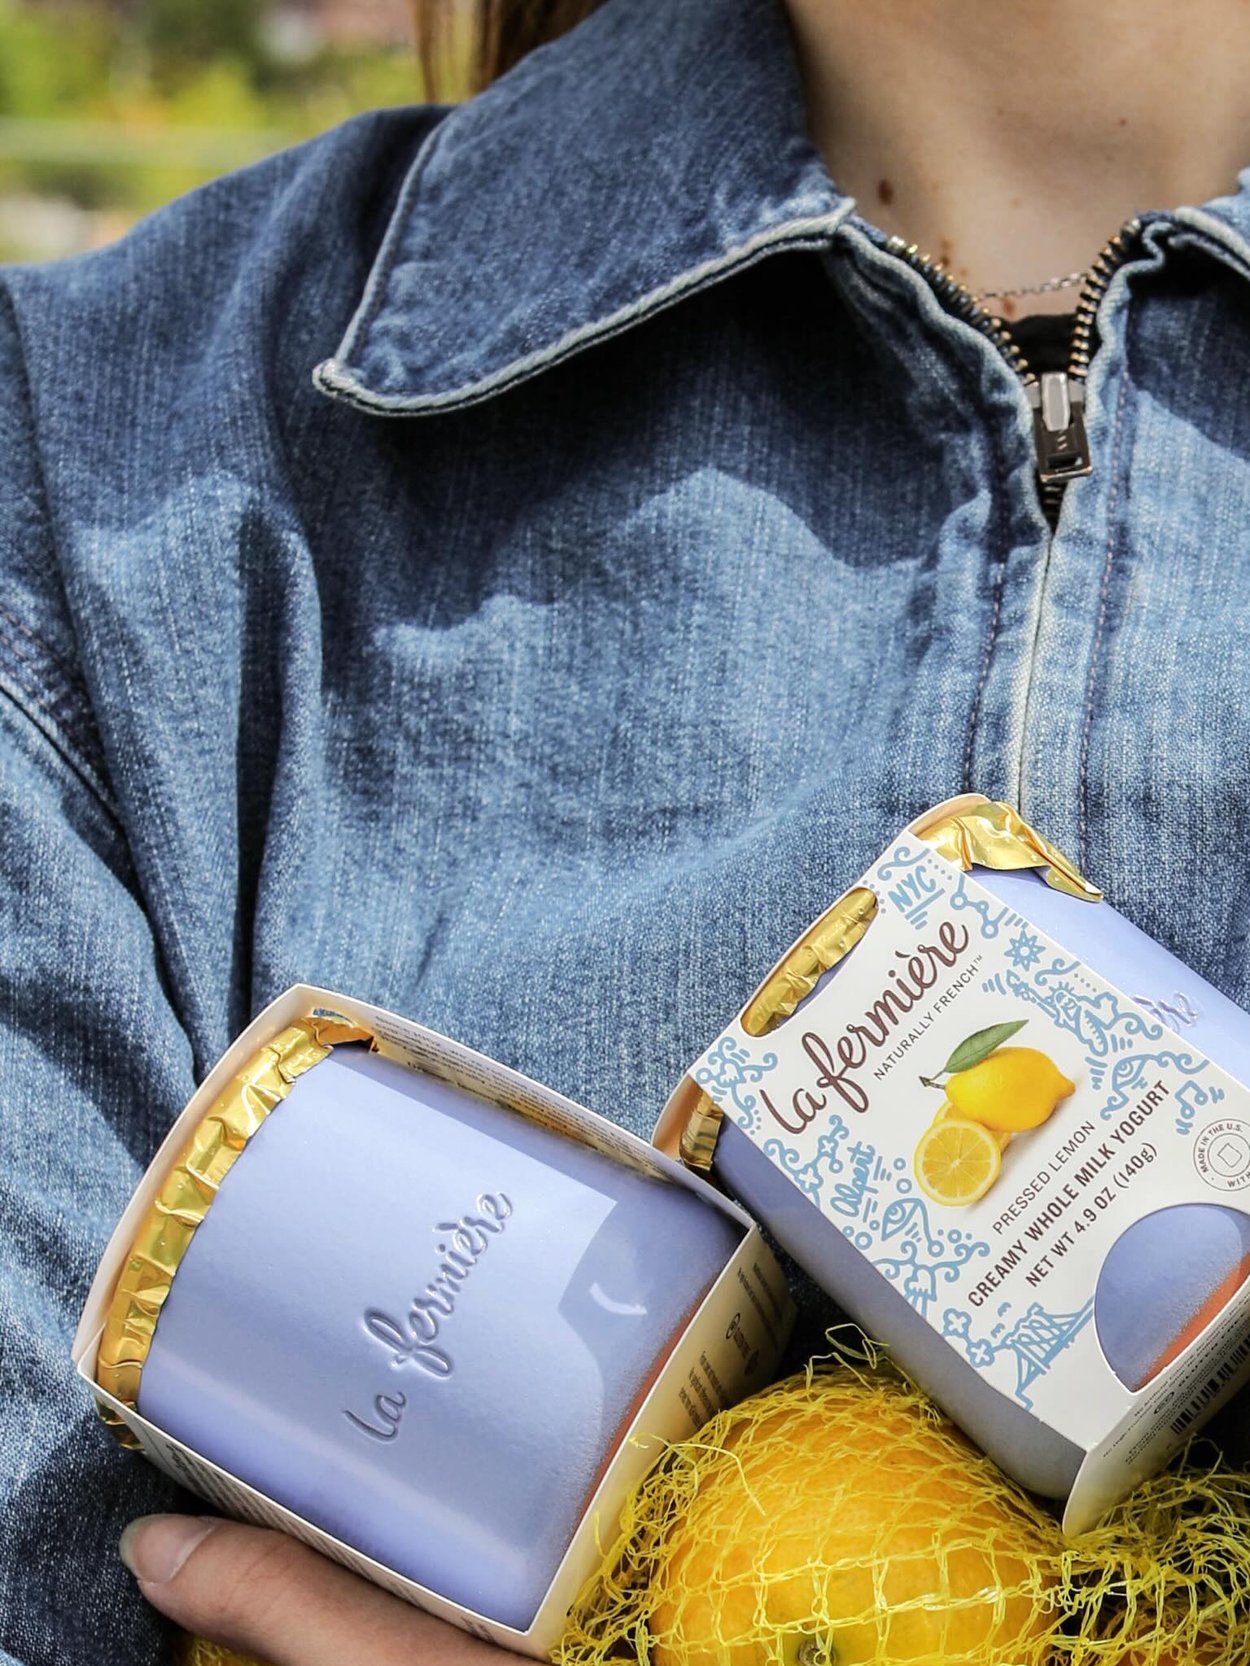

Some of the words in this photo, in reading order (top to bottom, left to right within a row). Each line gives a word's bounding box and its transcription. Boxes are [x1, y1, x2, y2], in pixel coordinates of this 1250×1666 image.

[888, 865, 936, 912] NYC
[759, 1087, 827, 1134] la
[801, 921, 969, 1113] fermière
[873, 1012, 934, 1080] NATURALLY
[1198, 1147, 1209, 1173] MADE
[1200, 1136, 1209, 1146] IN
[1208, 1124, 1224, 1136] THE
[968, 1238, 1029, 1307] CREAMY
[1025, 1184, 1079, 1242] WHOLE
[1074, 1143, 1116, 1187] MILK
[1110, 1080, 1171, 1145] YOGURT
[992, 1170, 1050, 1235] PRESSED
[1048, 1120, 1096, 1172] LEMON
[1025, 1257, 1055, 1288] NET
[1050, 1231, 1075, 1257] WT
[1075, 1208, 1097, 1233] 4.9
[1094, 1186, 1117, 1210] OZ
[1113, 1142, 1158, 1189] (140g)
[363, 1192, 514, 1379] fermière
[343, 1391, 407, 1442] la
